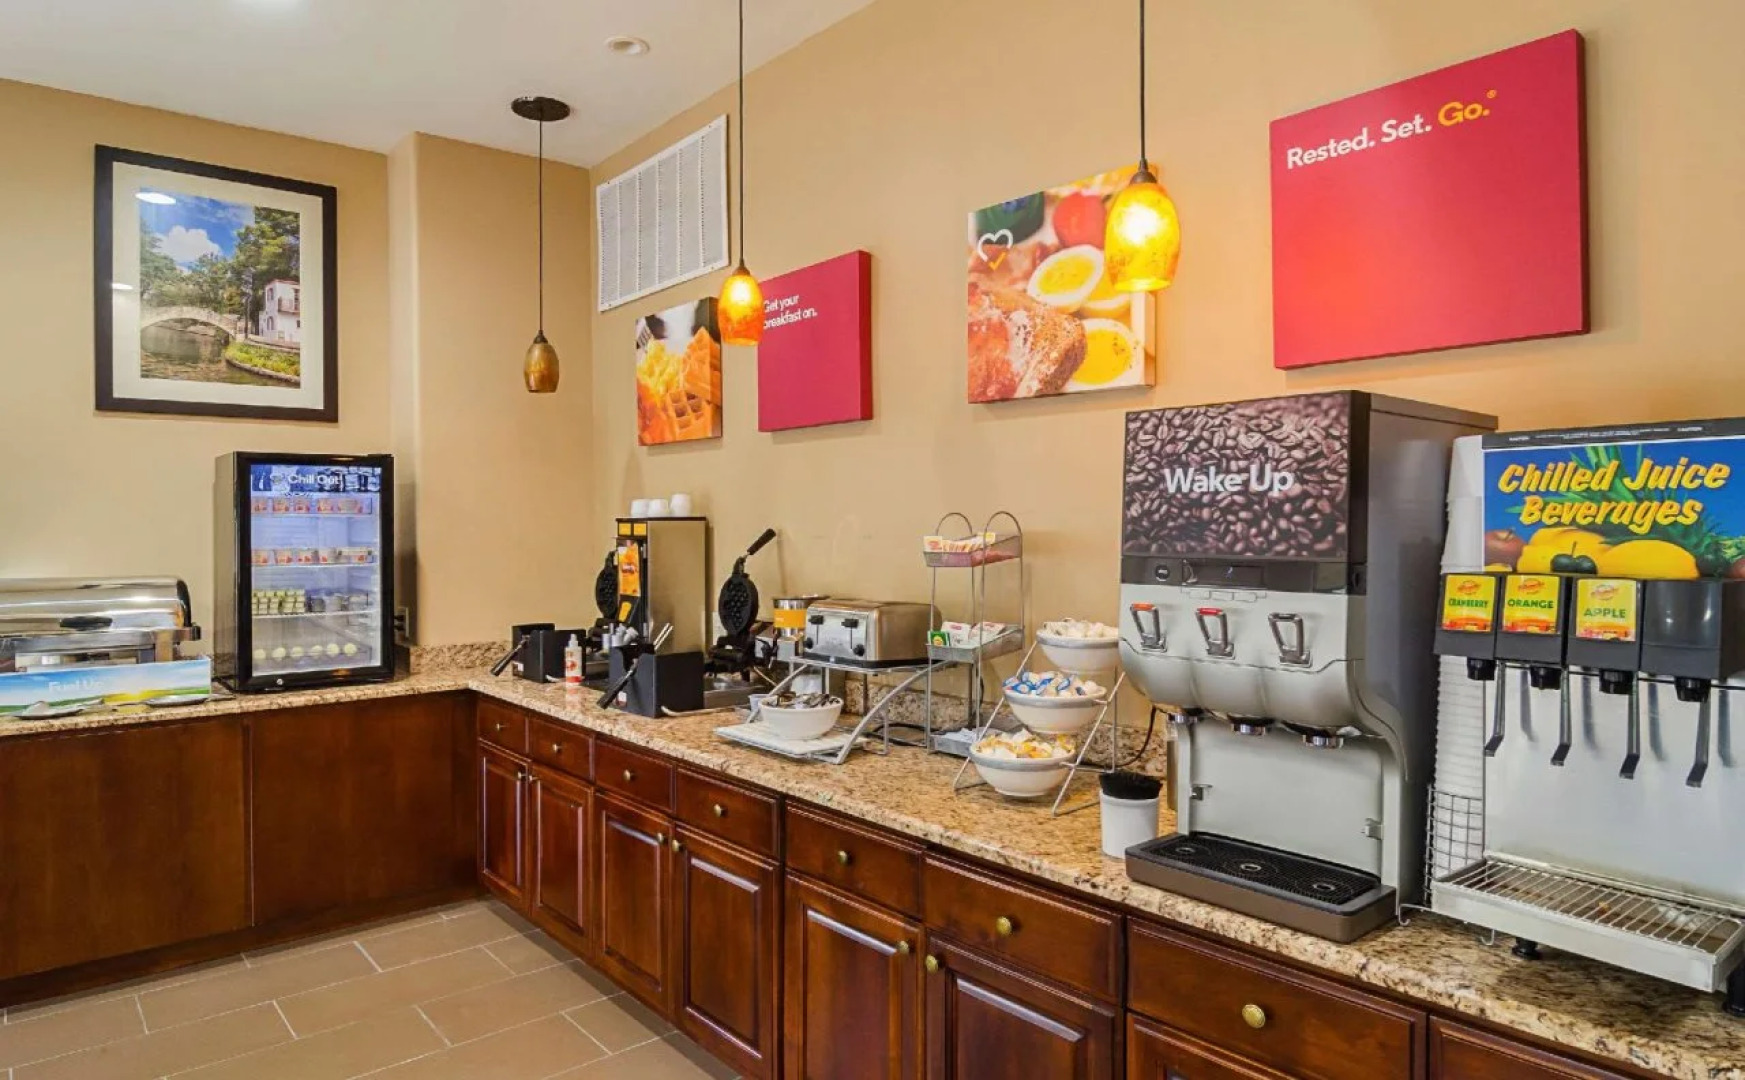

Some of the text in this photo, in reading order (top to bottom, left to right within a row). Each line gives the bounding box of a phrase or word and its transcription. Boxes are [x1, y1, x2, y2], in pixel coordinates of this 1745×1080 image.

[1287, 127, 1375, 169] Rested.
[1381, 114, 1432, 143] Set.
[1164, 463, 1295, 493] Wake Up
[1498, 457, 1731, 493] Chilled Juice
[1519, 494, 1704, 535] Beverages
[1507, 598, 1555, 609] ORANGE
[1583, 607, 1627, 619] APPLE
